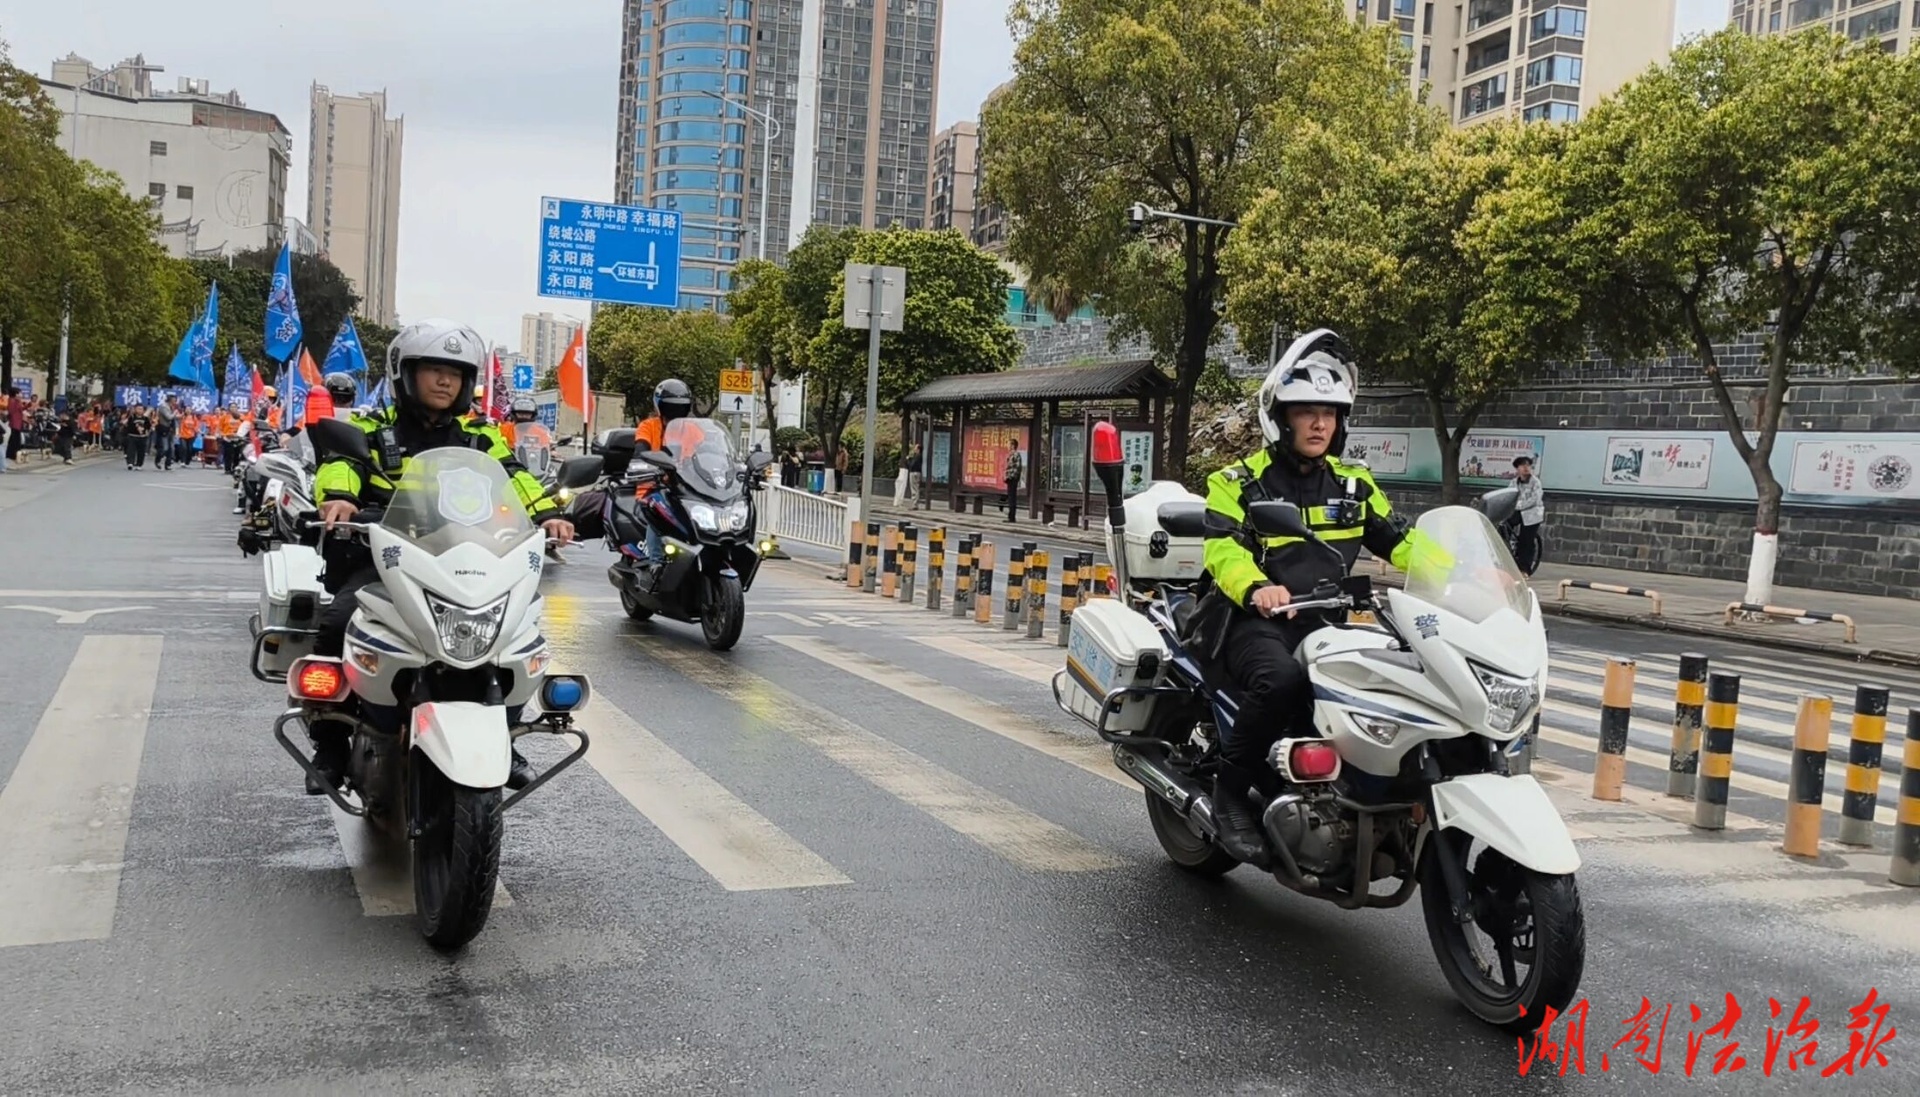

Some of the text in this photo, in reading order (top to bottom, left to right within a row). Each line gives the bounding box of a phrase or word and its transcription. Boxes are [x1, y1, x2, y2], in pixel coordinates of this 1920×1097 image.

[581, 205, 677, 229] 永明中路 幸福路
[548, 224, 596, 243] 绕城公路
[633, 227, 660, 235] XINGFU
[547, 249, 595, 267] 永阳路
[547, 272, 594, 290] 永回路
[617, 266, 655, 280] 环城东路
[546, 289, 580, 297] YONGHUI
[725, 374, 753, 389] S28
[122, 388, 143, 405] 你
[191, 397, 211, 413] 欢
[228, 396, 248, 413] 迎
[382, 545, 402, 570] 警
[528, 550, 541, 574] 察
[1413, 613, 1440, 640] 警
